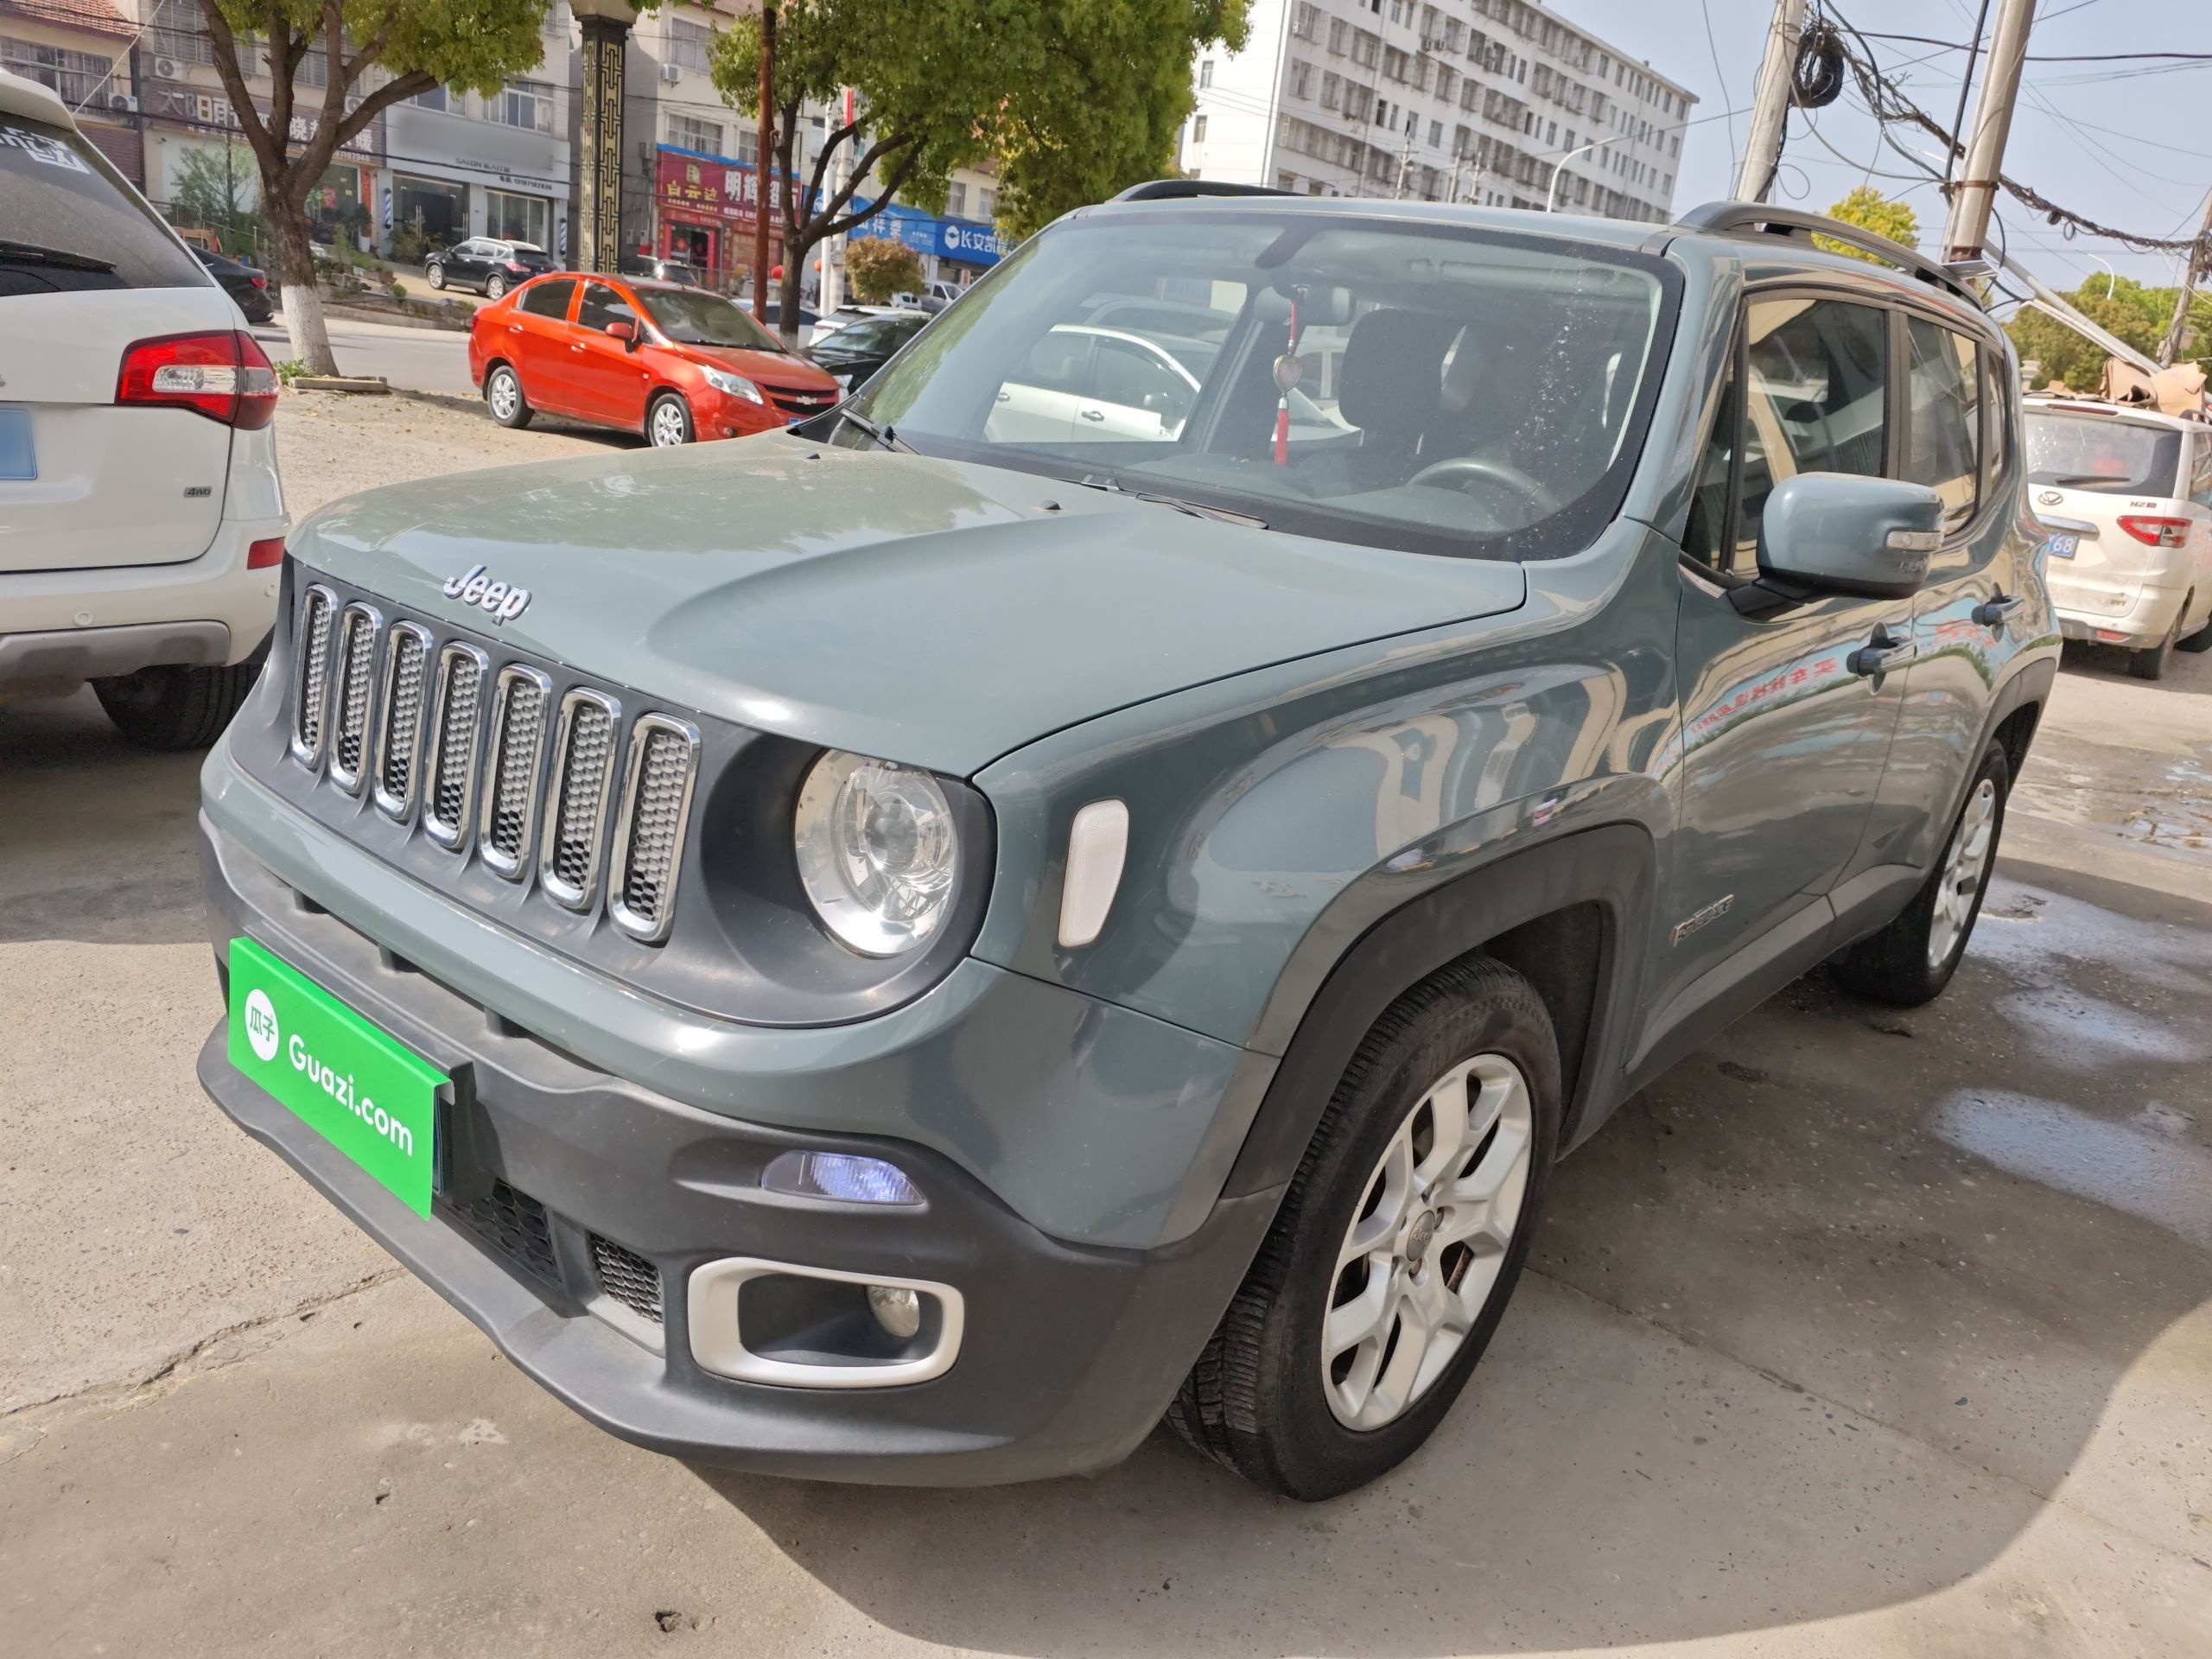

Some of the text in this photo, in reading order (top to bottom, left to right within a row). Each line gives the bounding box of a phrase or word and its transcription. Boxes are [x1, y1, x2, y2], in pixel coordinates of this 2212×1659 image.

[455, 157, 482, 168] SALON
[667, 180, 719, 201] 白云边
[187, 487, 212, 496] 4WD
[2049, 536, 2075, 554] 68
[443, 563, 532, 626] Jeep
[250, 1006, 412, 1157] 瓜子 Guazi.com
